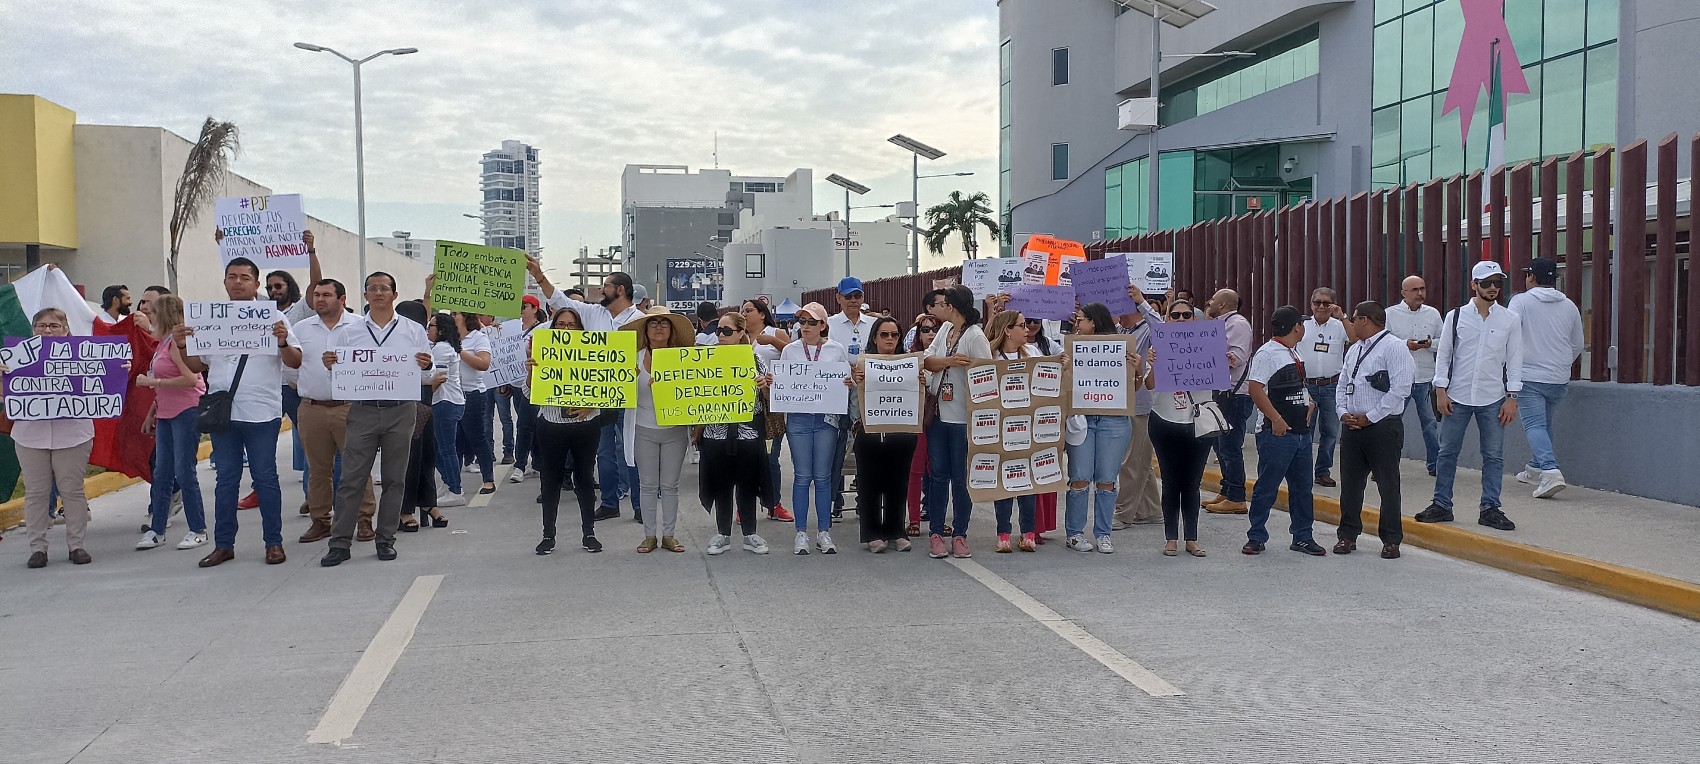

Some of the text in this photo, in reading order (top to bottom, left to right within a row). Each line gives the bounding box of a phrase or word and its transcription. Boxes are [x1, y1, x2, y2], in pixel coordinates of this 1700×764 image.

[221, 211, 282, 227] DEFIENDE TUS
[223, 222, 299, 238] DERECHOS ANTE EL
[260, 234, 275, 244] QUE
[227, 243, 309, 259] PAGA TU AGUINALDO
[440, 244, 469, 259] Todo
[475, 253, 507, 265] embate
[437, 259, 513, 280] la INDEPENDENCIA
[437, 270, 478, 286] JUDICIAL
[497, 282, 513, 290] una
[436, 284, 516, 301] afrenta al ESTADO
[434, 293, 486, 309] DE DERECHO
[190, 303, 271, 321] El PJF sirve
[551, 330, 607, 346] NO SON
[1154, 329, 1164, 339] Yo
[1211, 327, 1219, 338] el
[194, 337, 271, 350] tus bienes!!!
[1075, 344, 1122, 354] En el PJF
[1169, 342, 1204, 354] Poder
[0, 336, 132, 367] PJF LA ÚLTIMA
[352, 350, 377, 363] PJF
[382, 352, 408, 363] sirve
[541, 347, 626, 363] PRIVILEGIOS
[679, 347, 716, 362] PJF
[45, 361, 106, 375] DEFENSA
[868, 361, 914, 371] Trabajamos
[1074, 358, 1123, 368] te damos
[1167, 356, 1217, 373] Judicial
[335, 369, 356, 379] para
[361, 368, 400, 379] proteger
[539, 367, 563, 381] SON
[570, 367, 635, 383] NUESTROS
[654, 367, 756, 382] DEFIENDE TUS
[774, 363, 848, 382] El PJF depende
[879, 374, 904, 383] duro
[1173, 373, 1214, 387] Federal
[11, 377, 103, 393] CONTRA LA
[774, 381, 828, 391] tus derechos
[974, 376, 994, 385] AMPARO
[1078, 378, 1120, 388] un trato
[553, 384, 625, 400] DERECHOS
[675, 384, 744, 400] DERECHOS
[774, 393, 822, 403] laborales!!!
[1083, 391, 1114, 403] digno
[8, 396, 121, 418] DICTADURA
[879, 395, 904, 405] para
[660, 399, 754, 420] TUS GARANTÍAS
[868, 408, 914, 418] servirles
